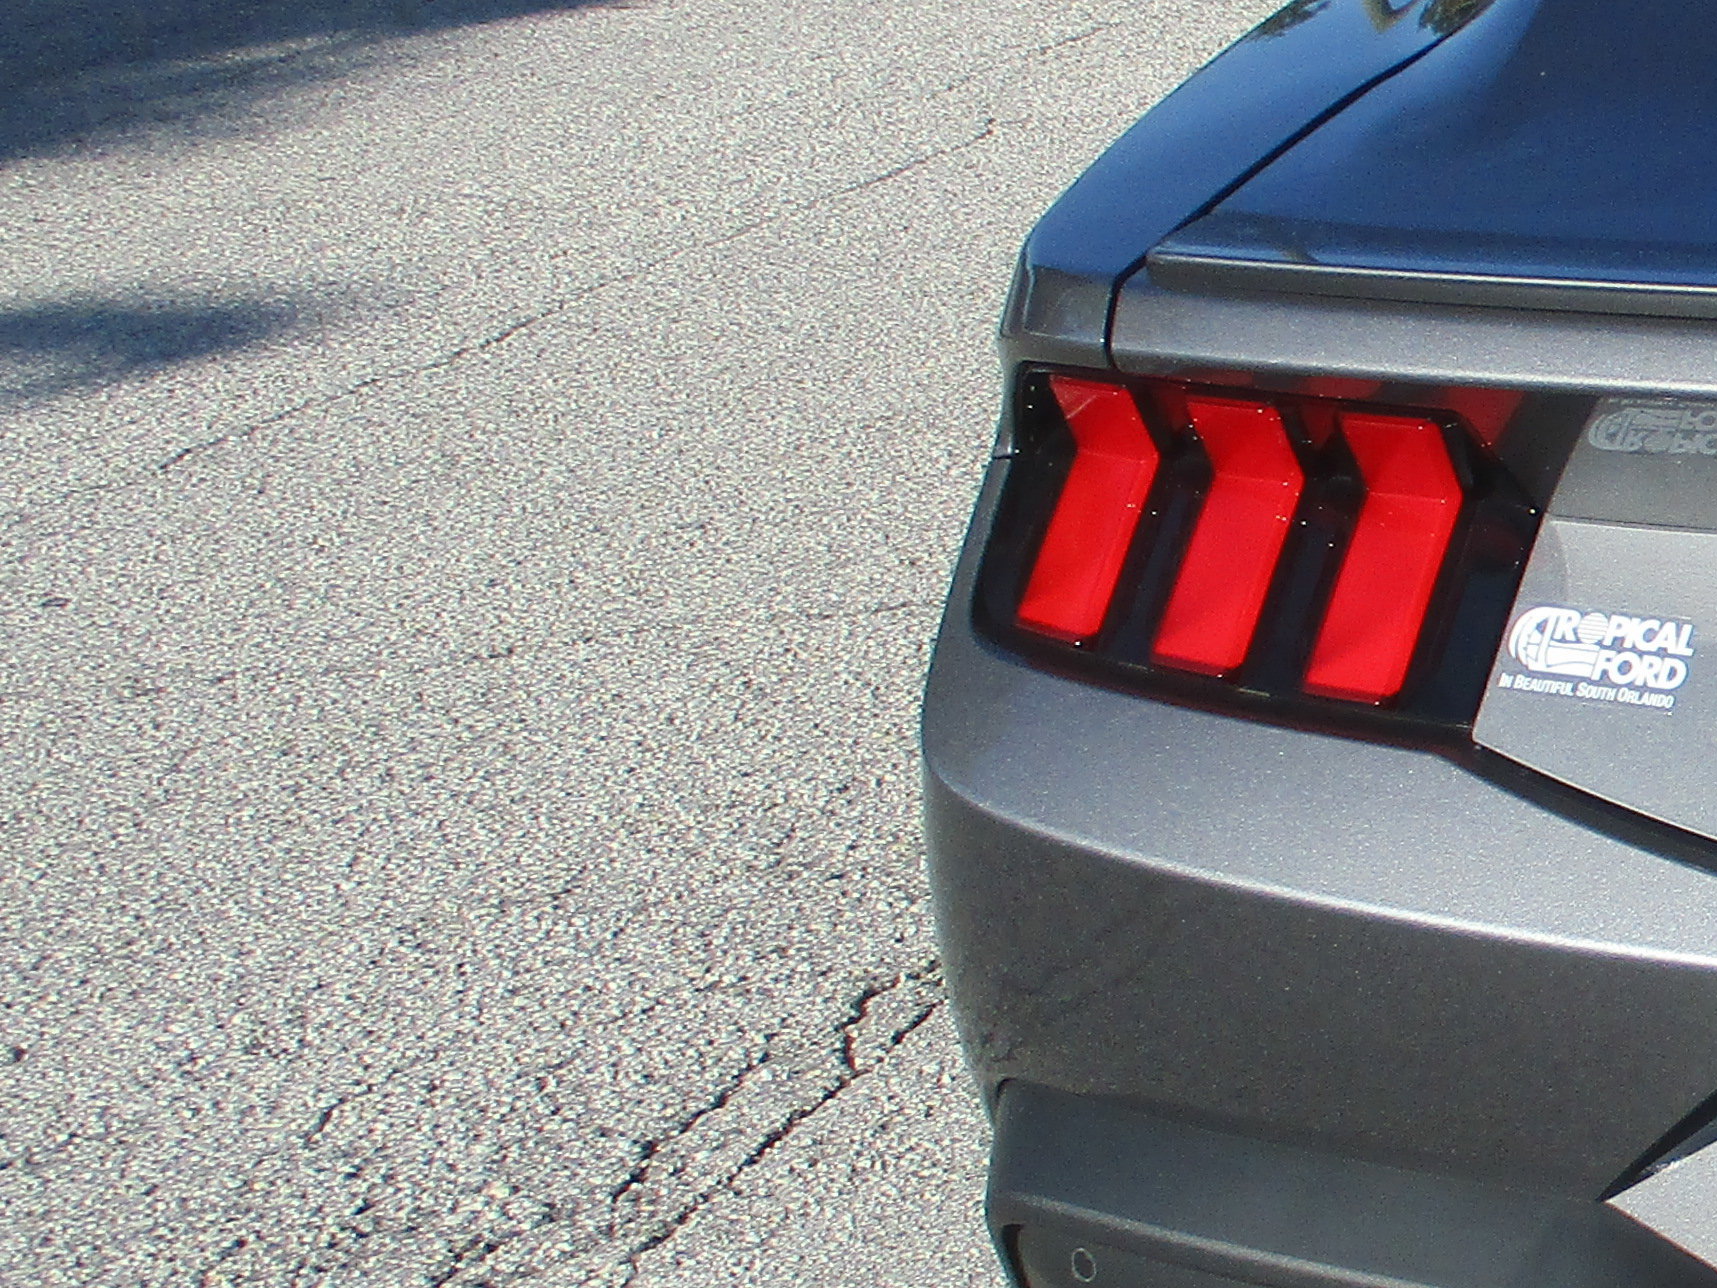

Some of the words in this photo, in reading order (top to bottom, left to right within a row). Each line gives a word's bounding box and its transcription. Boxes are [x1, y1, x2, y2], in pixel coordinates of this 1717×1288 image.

[1591, 649, 1688, 690] FORD
[1498, 673, 1513, 688] IN
[1576, 682, 1617, 702] SOUTH
